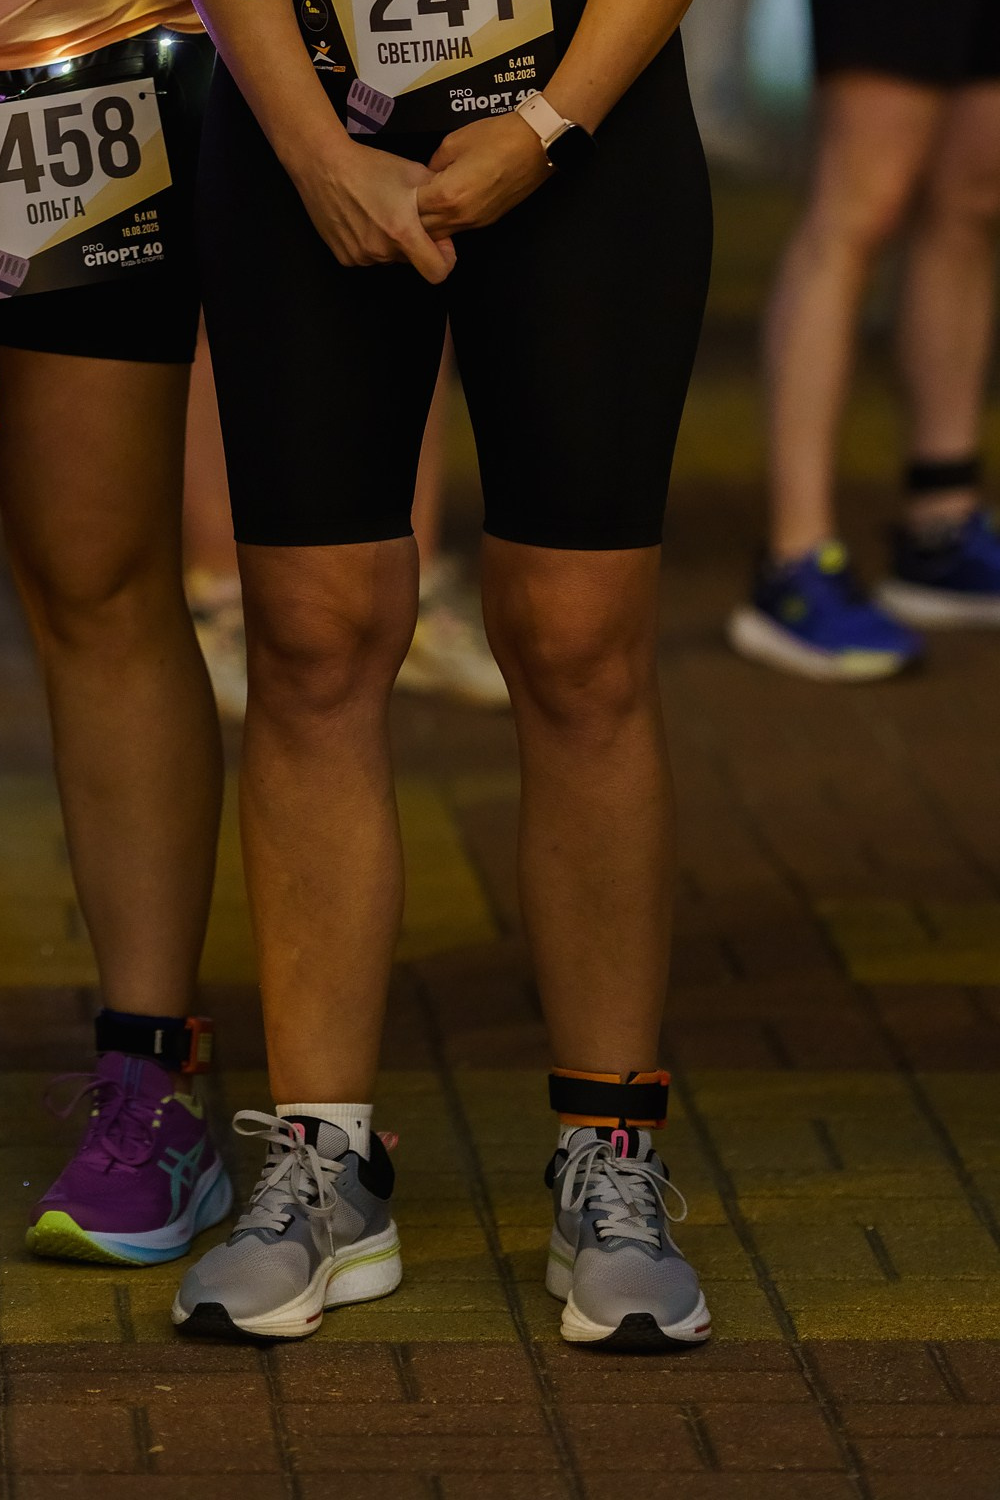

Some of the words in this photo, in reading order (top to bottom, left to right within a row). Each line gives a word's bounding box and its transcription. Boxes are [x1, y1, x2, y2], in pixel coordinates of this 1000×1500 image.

[377, 36, 474, 65] СВЕТЛАНА
[508, 57, 522, 69] 6,4
[493, 68, 537, 84] 16.08.2025
[449, 88, 473, 99] PRO
[450, 91, 513, 113] СПОРТ
[26, 195, 86, 225] ОЛЬГА
[81, 242, 104, 254] PRO
[83, 245, 140, 267] СПОРТ
[142, 241, 163, 257] 40
